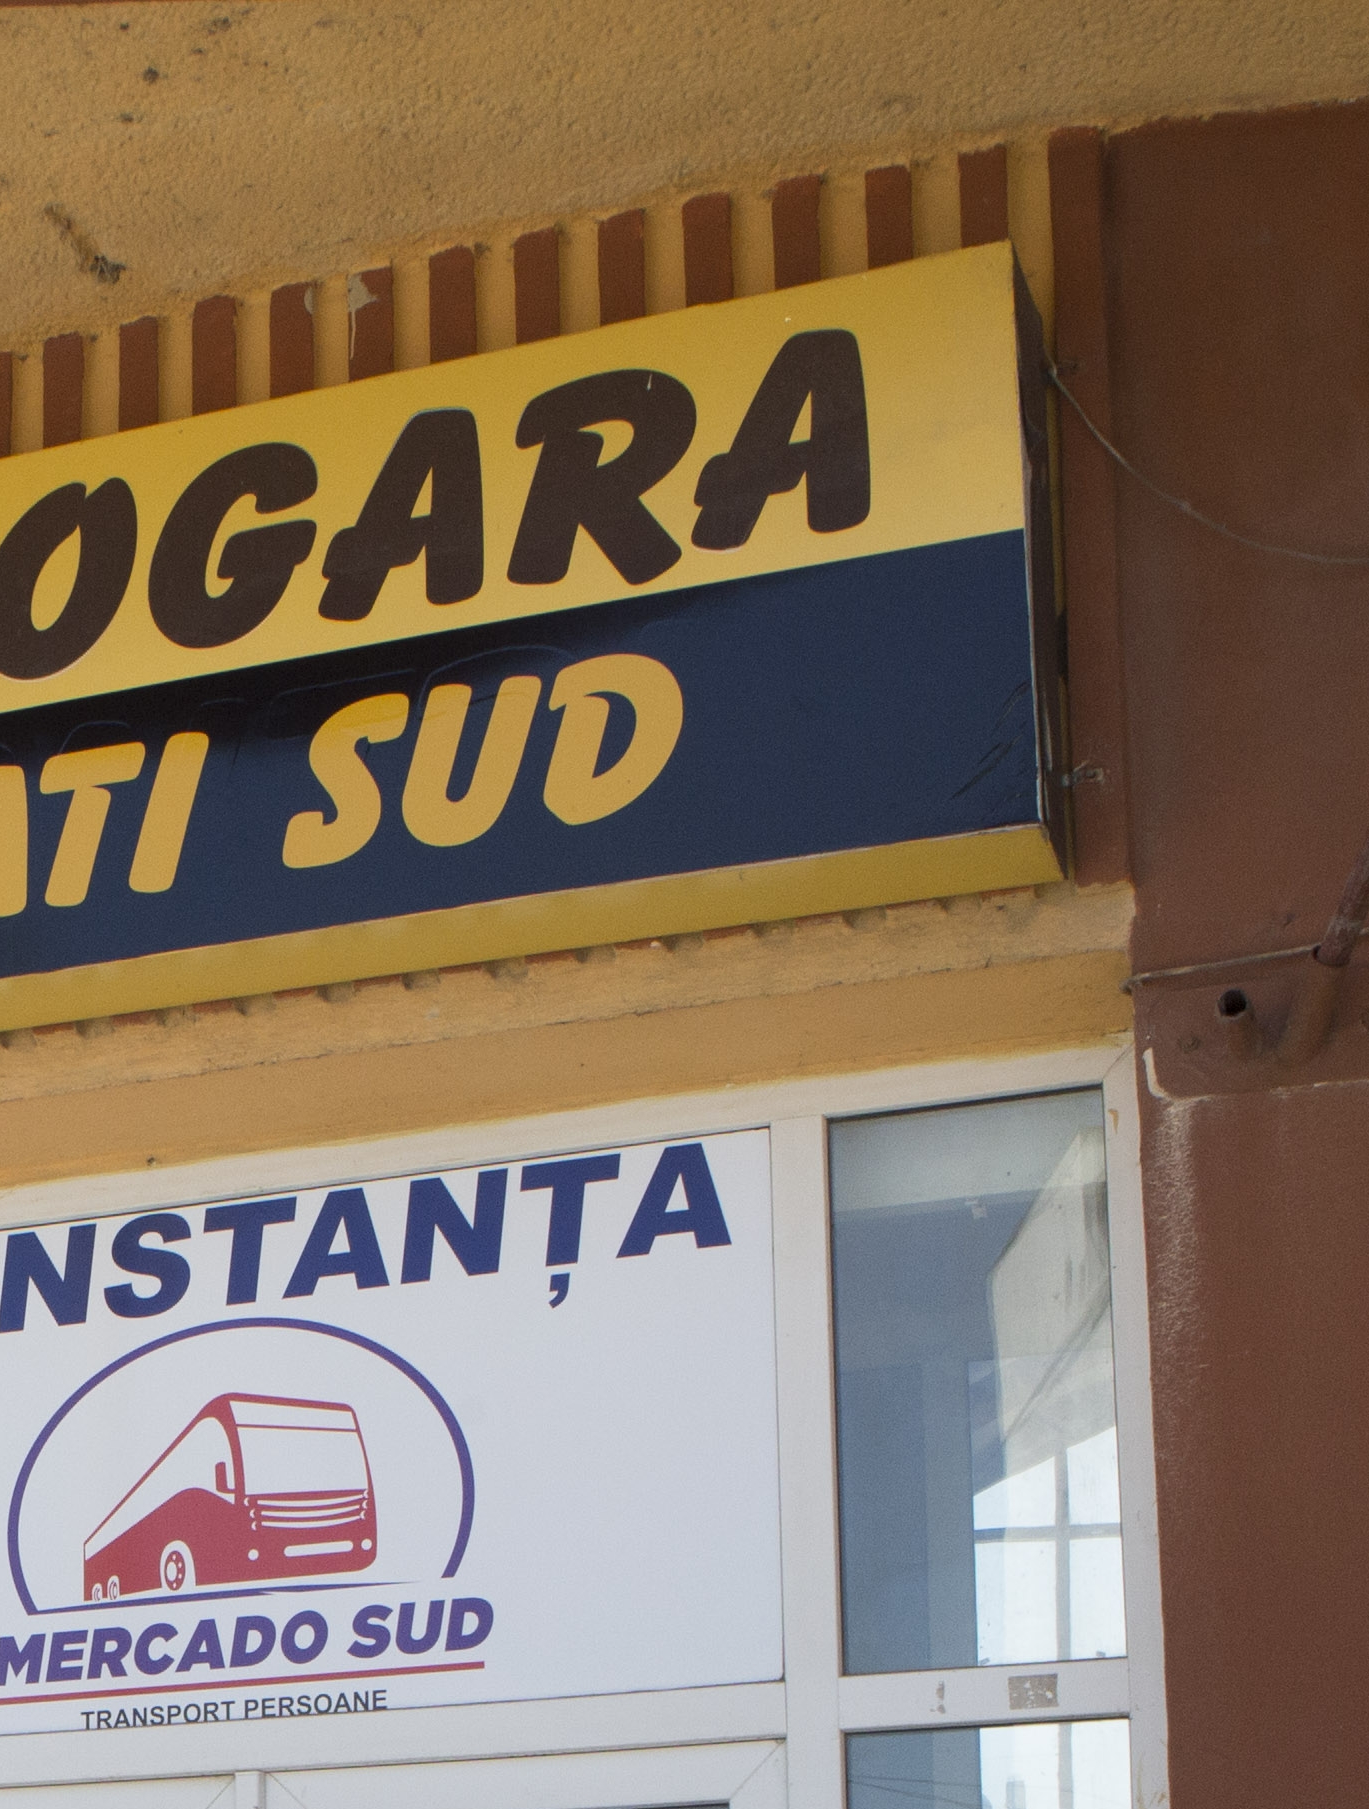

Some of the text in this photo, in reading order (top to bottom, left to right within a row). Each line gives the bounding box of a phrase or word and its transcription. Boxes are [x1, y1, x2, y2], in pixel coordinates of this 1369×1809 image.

[283, 653, 684, 868] SUD
[348, 1597, 494, 1657] SUD
[81, 1689, 388, 1730] TRANSPORT PERSOANE
